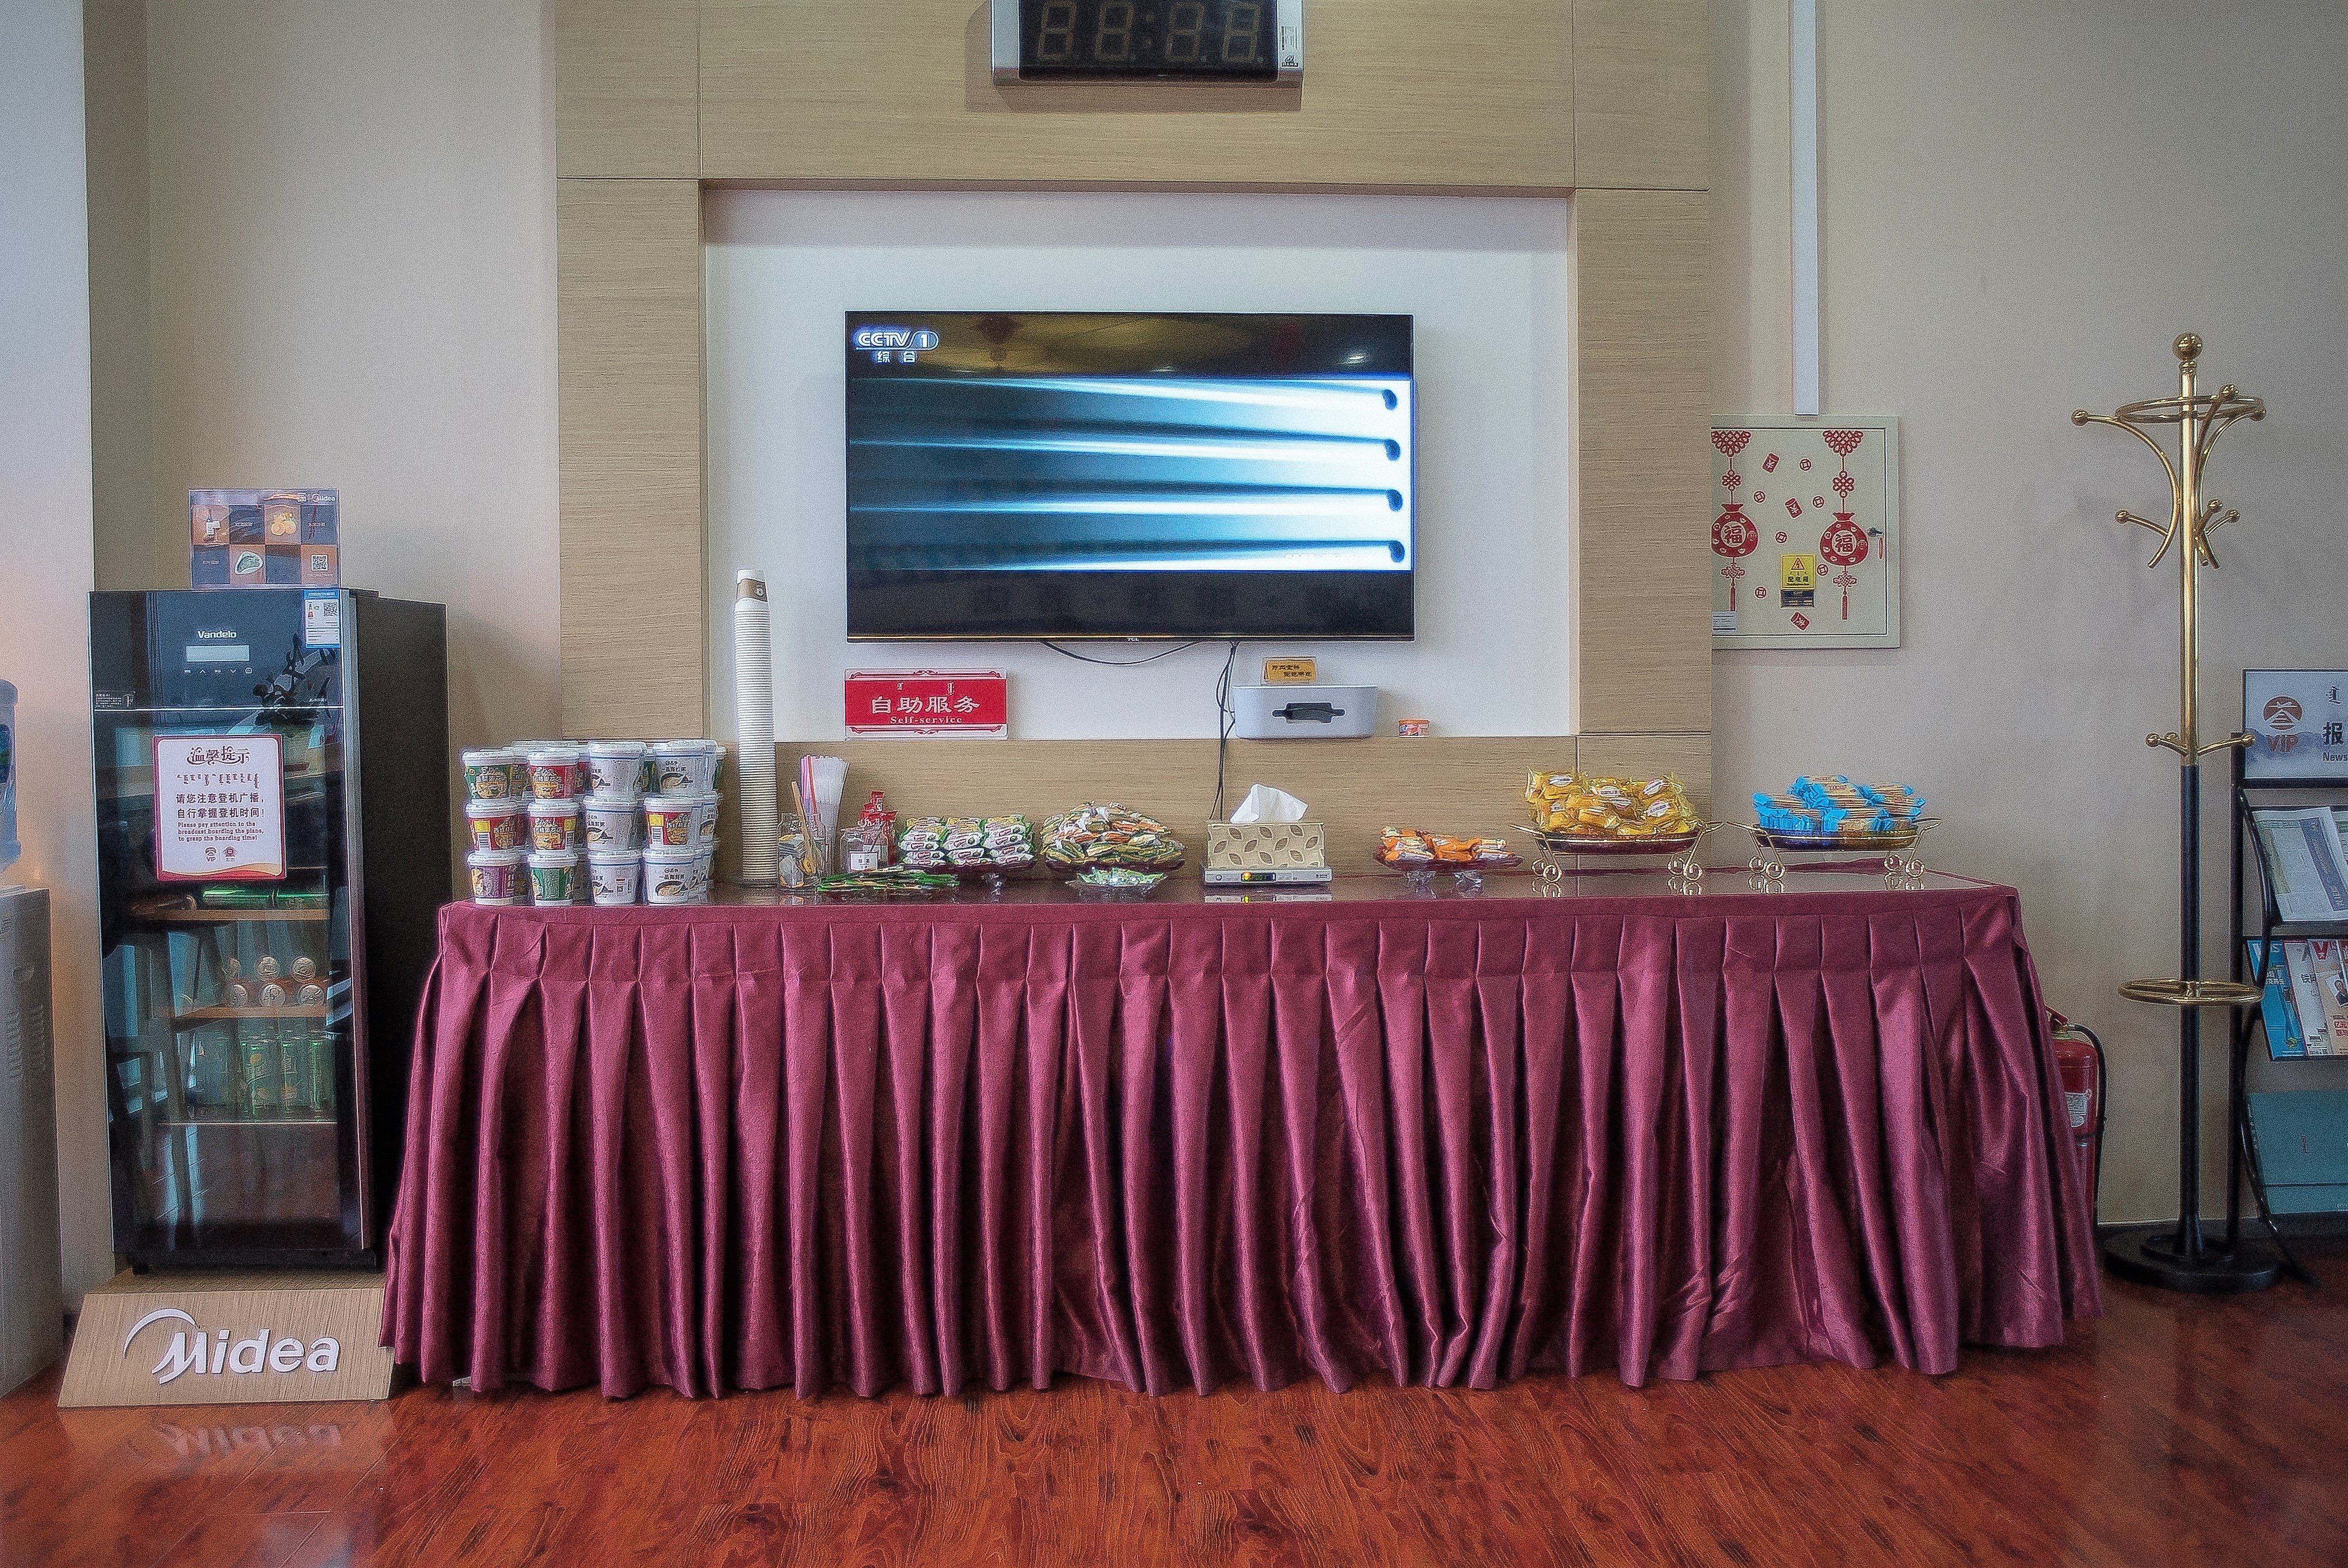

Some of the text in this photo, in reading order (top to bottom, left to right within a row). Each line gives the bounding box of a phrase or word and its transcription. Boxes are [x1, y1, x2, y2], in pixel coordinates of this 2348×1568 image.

[857, 332, 911, 346] CCTV
[877, 351, 916, 363] 综合
[1724, 525, 1743, 544] 福
[1835, 534, 1854, 552] 福
[197, 631, 237, 639] Vandelo
[871, 696, 980, 714] 自助服务
[890, 716, 963, 725] Self-service
[2322, 722, 2345, 745] 报
[2266, 735, 2299, 752] VIP
[187, 746, 250, 765] 温馨提示
[151, 1326, 340, 1384] Midea
